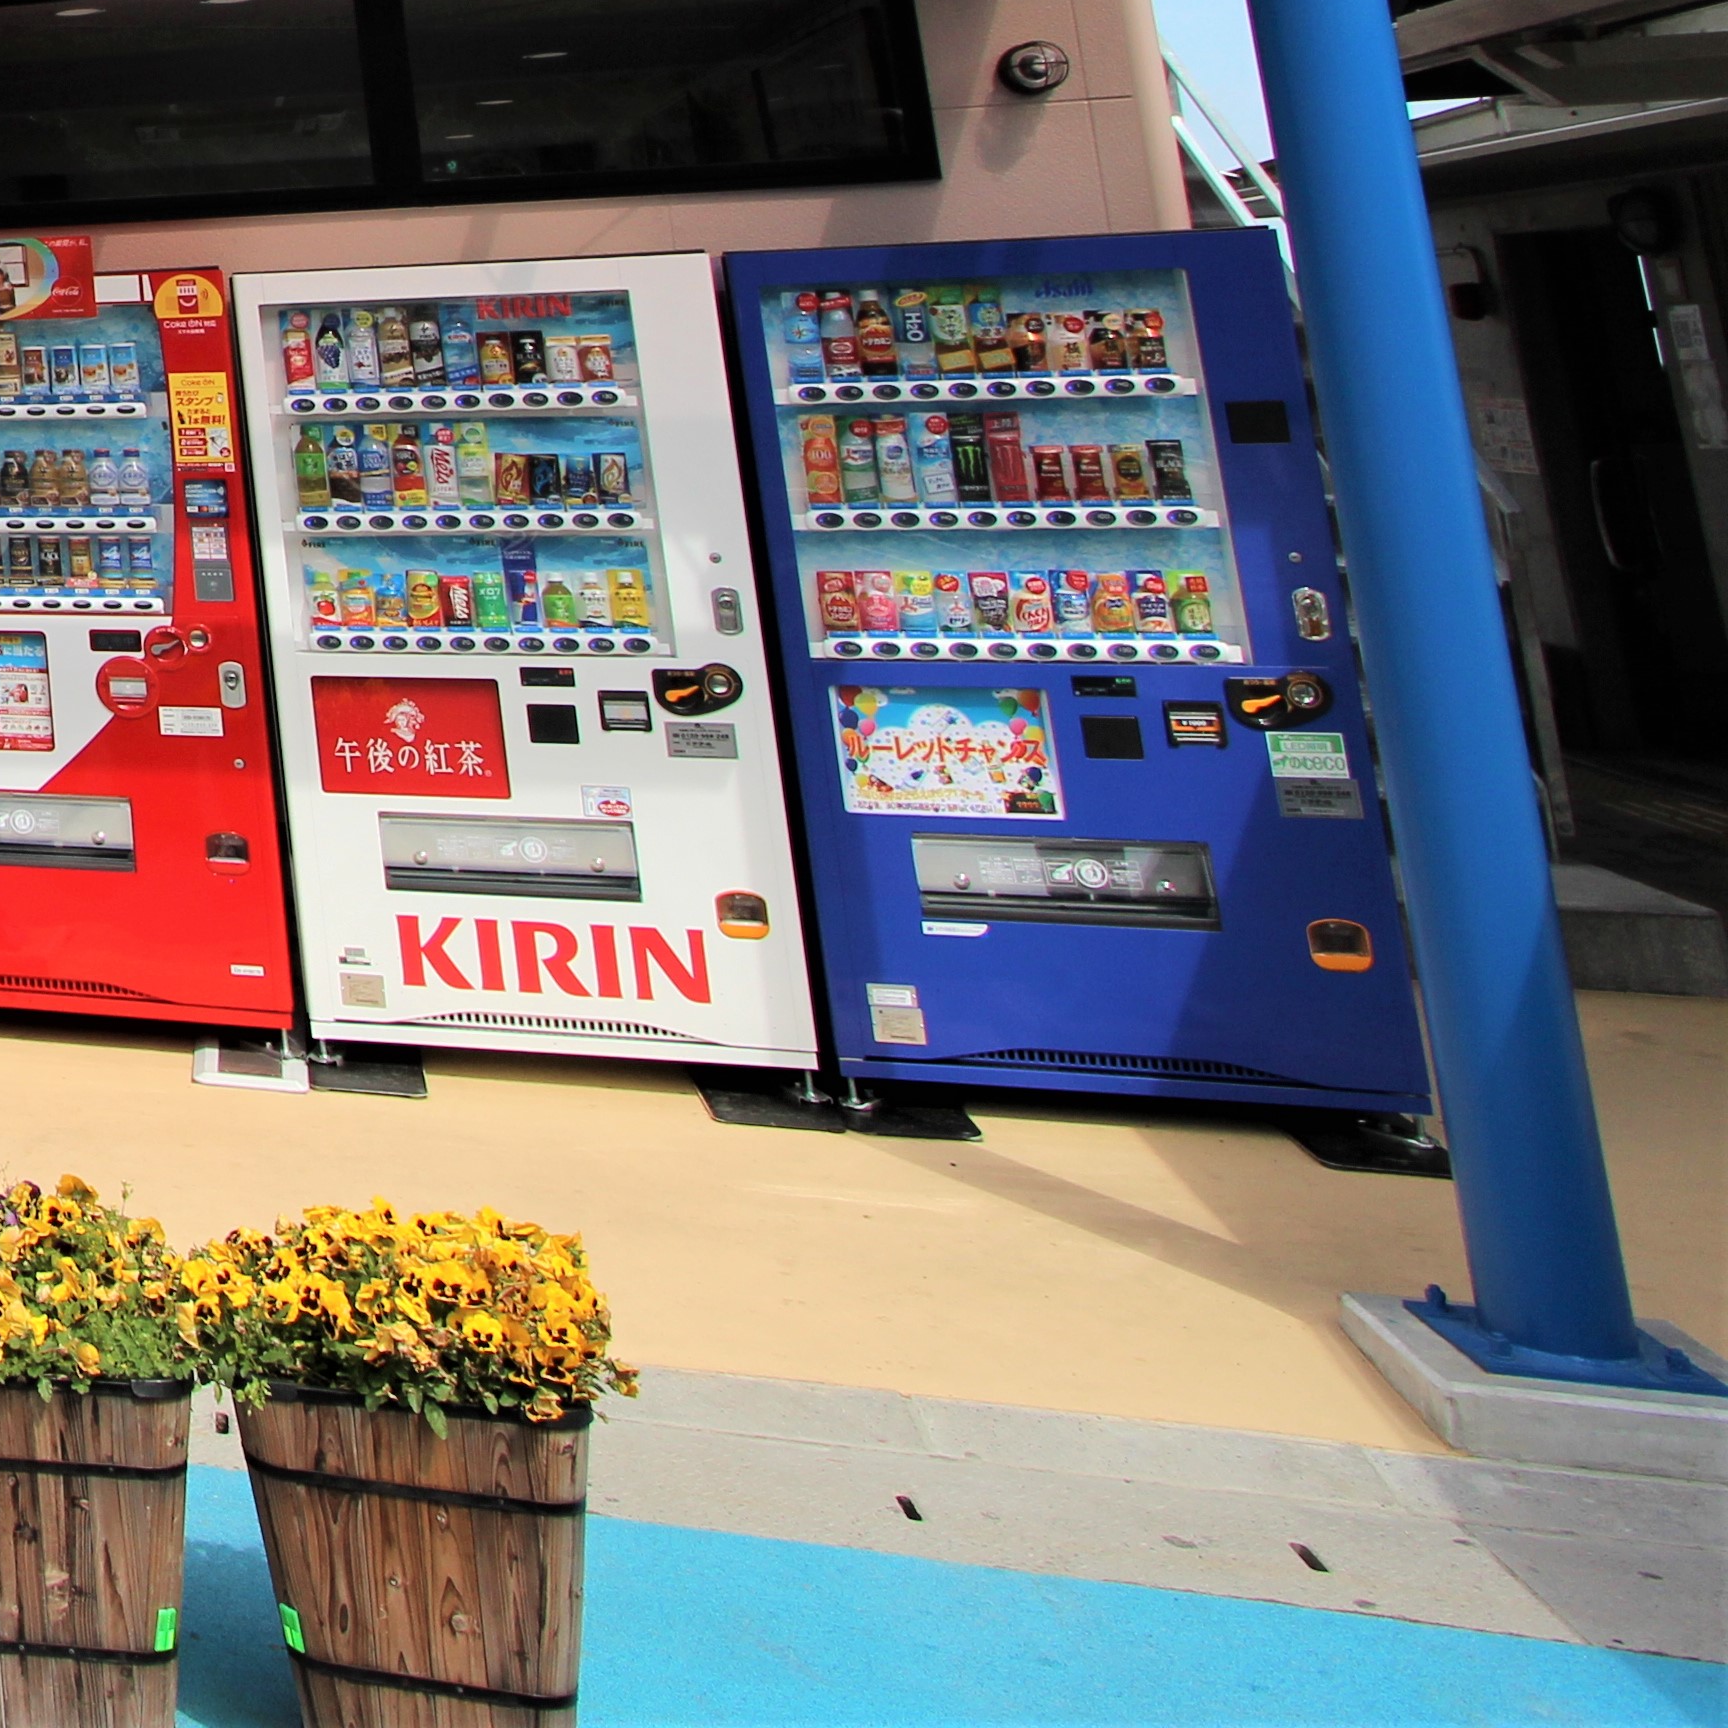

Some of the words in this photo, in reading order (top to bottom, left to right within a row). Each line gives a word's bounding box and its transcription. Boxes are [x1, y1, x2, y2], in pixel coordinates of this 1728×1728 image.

[476, 295, 572, 320] KIRIN
[334, 738, 484, 777] 午後の紅茶
[848, 736, 1048, 768] ルーレットチャンス
[395, 914, 712, 1004] KIRIN
